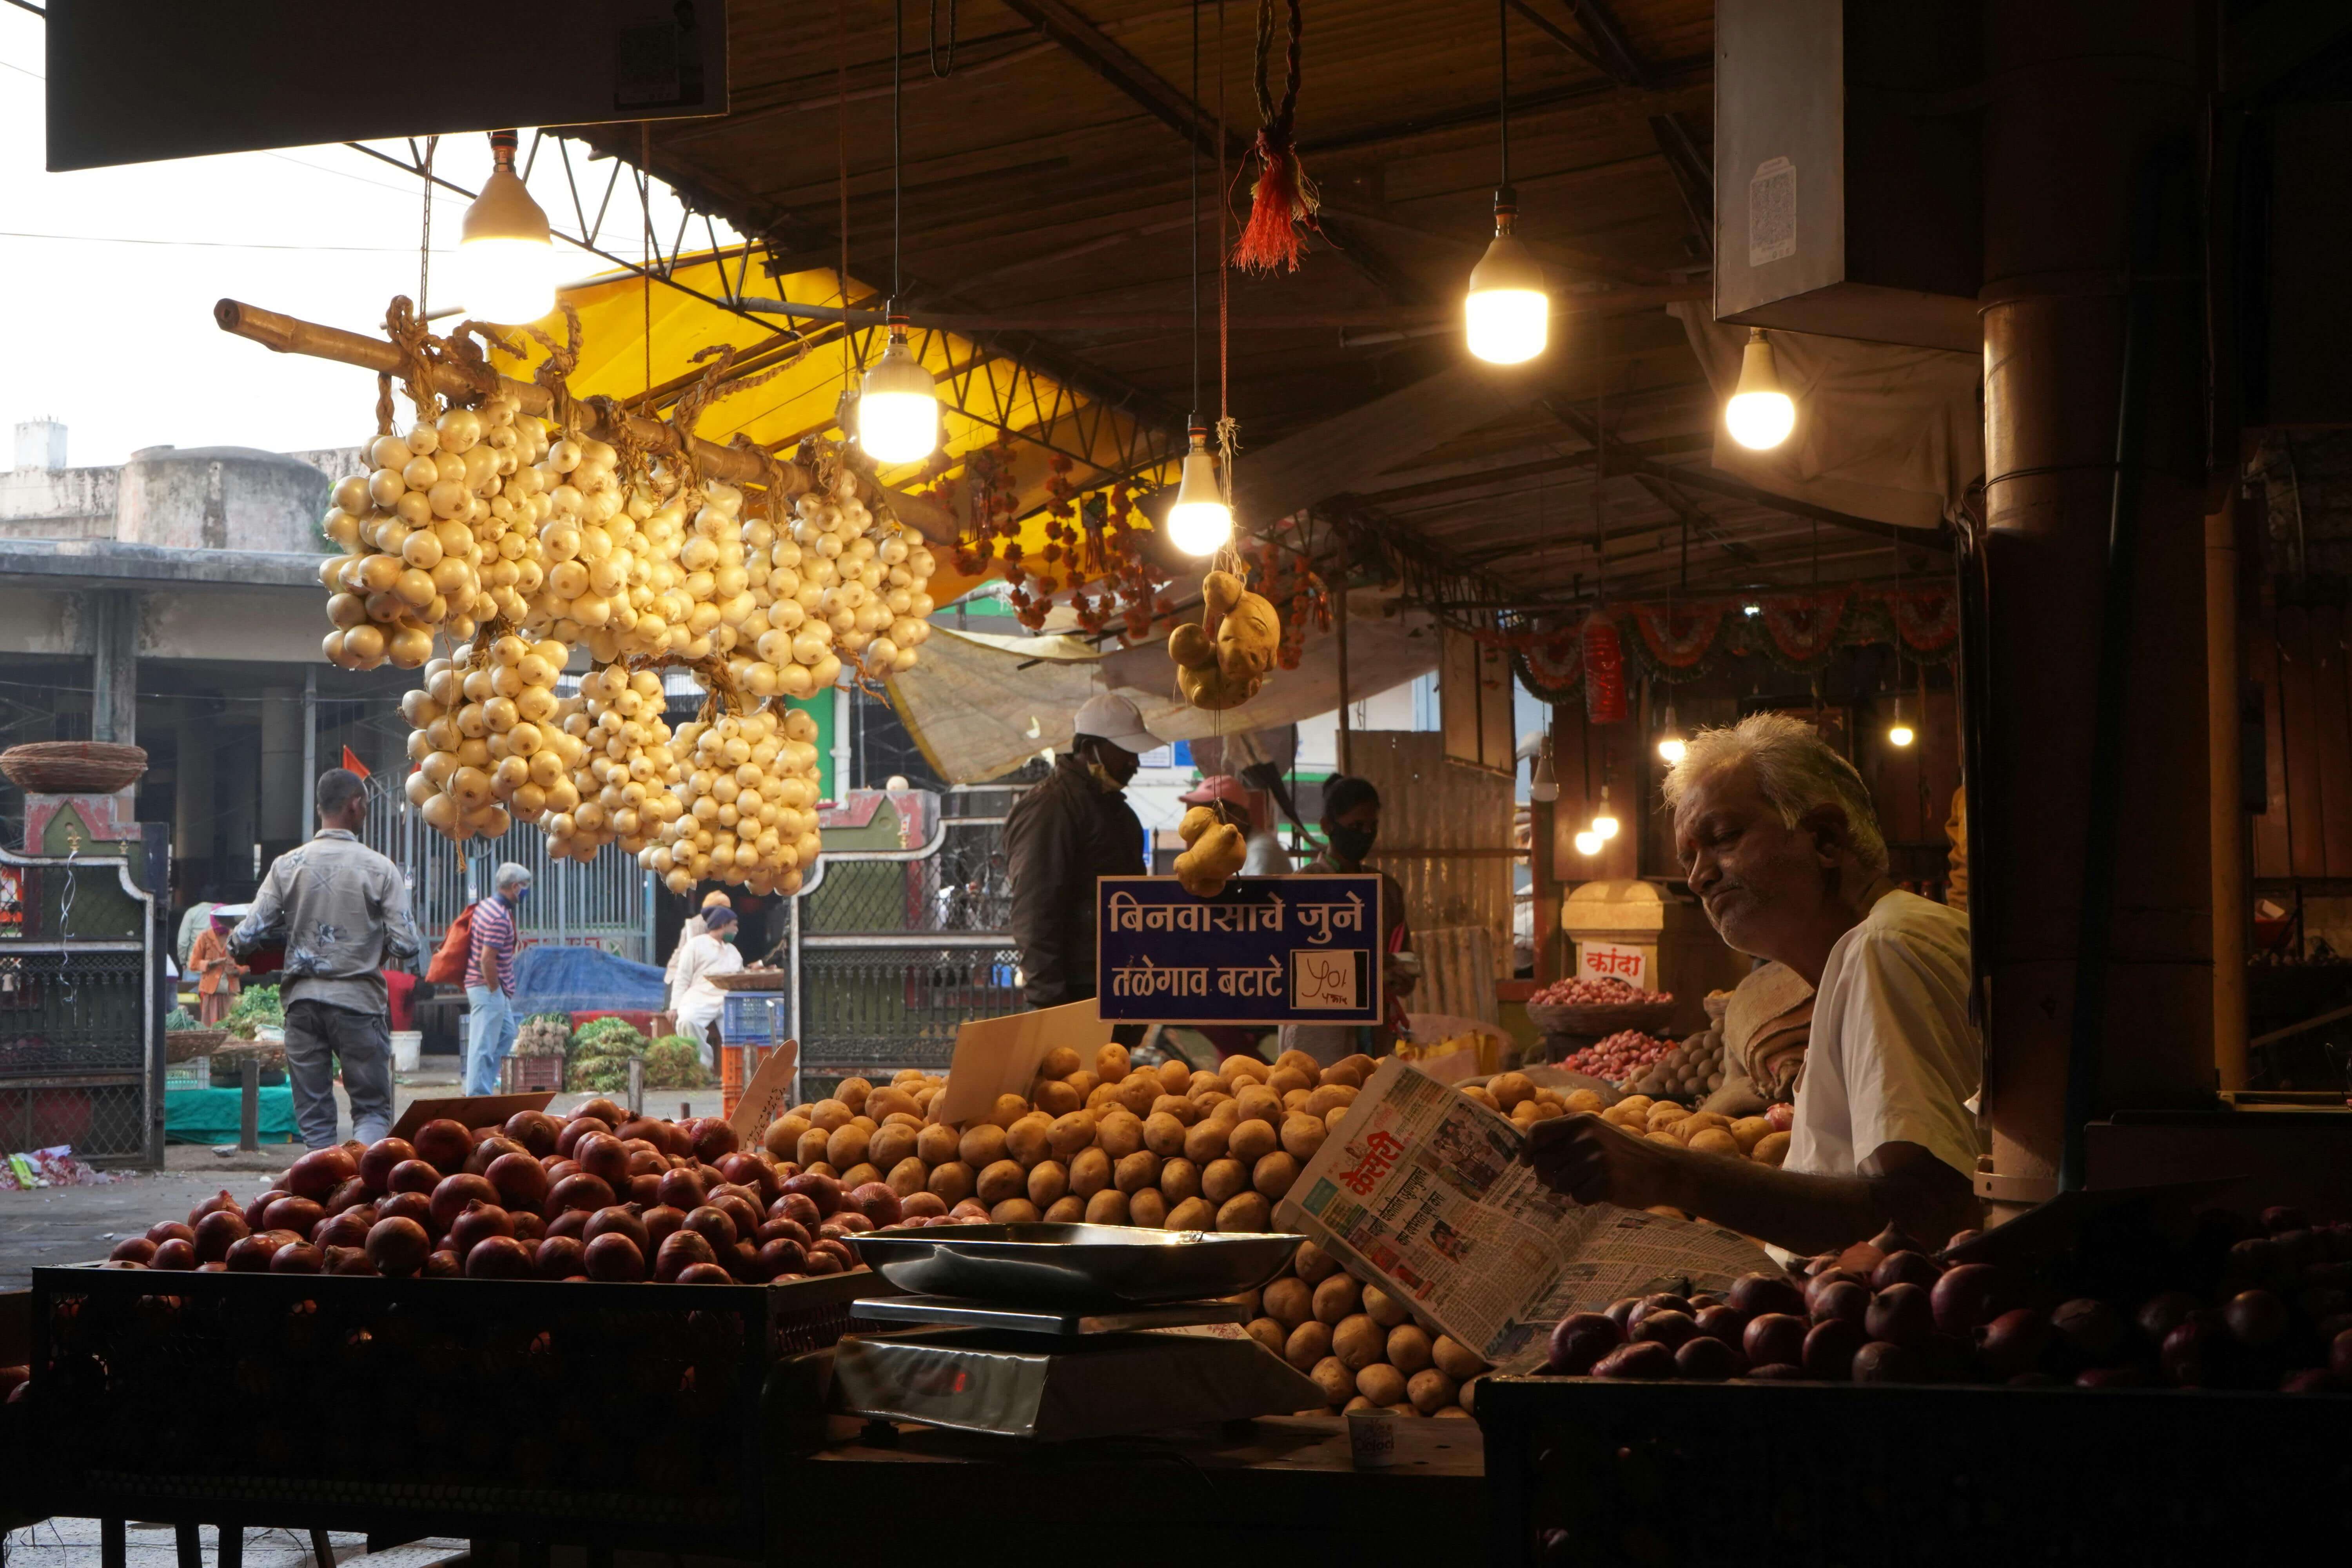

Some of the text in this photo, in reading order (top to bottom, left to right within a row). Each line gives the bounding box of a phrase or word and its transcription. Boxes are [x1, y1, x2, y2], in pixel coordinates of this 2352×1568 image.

[1108, 891, 1365, 944] बिनवासाचे जुने
[1111, 954, 1284, 996] तळेगाव बटाटे
[1586, 947, 1642, 976] कांदा
[1339, 1131, 1405, 1196] केसरी
[1420, 1197, 1440, 1220] पूर्ण
[1428, 1191, 1446, 1207] करा
[1395, 1231, 1413, 1246] काम
